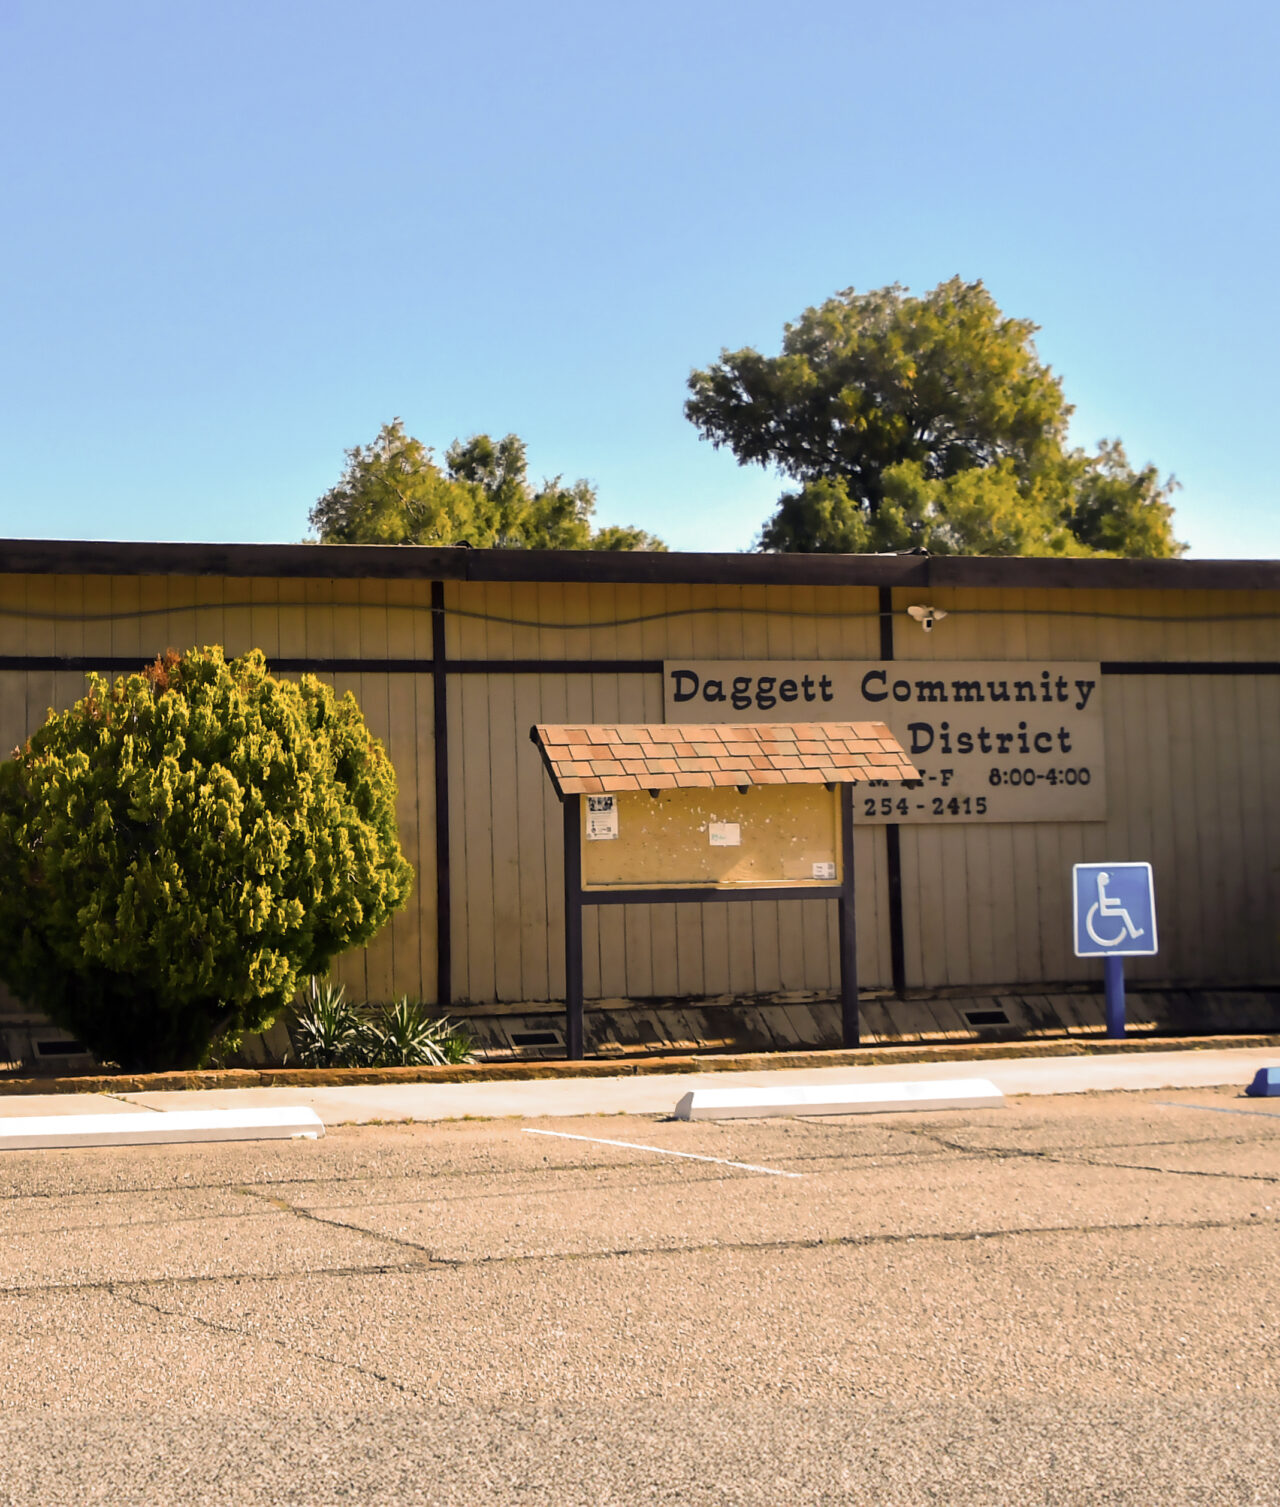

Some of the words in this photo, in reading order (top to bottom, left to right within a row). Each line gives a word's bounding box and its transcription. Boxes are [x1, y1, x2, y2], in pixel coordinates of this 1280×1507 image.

[670, 669, 834, 710] Daggett
[861, 669, 1096, 710] Community
[907, 721, 1073, 755] District
[988, 767, 1092, 786] 8:00-4:00
